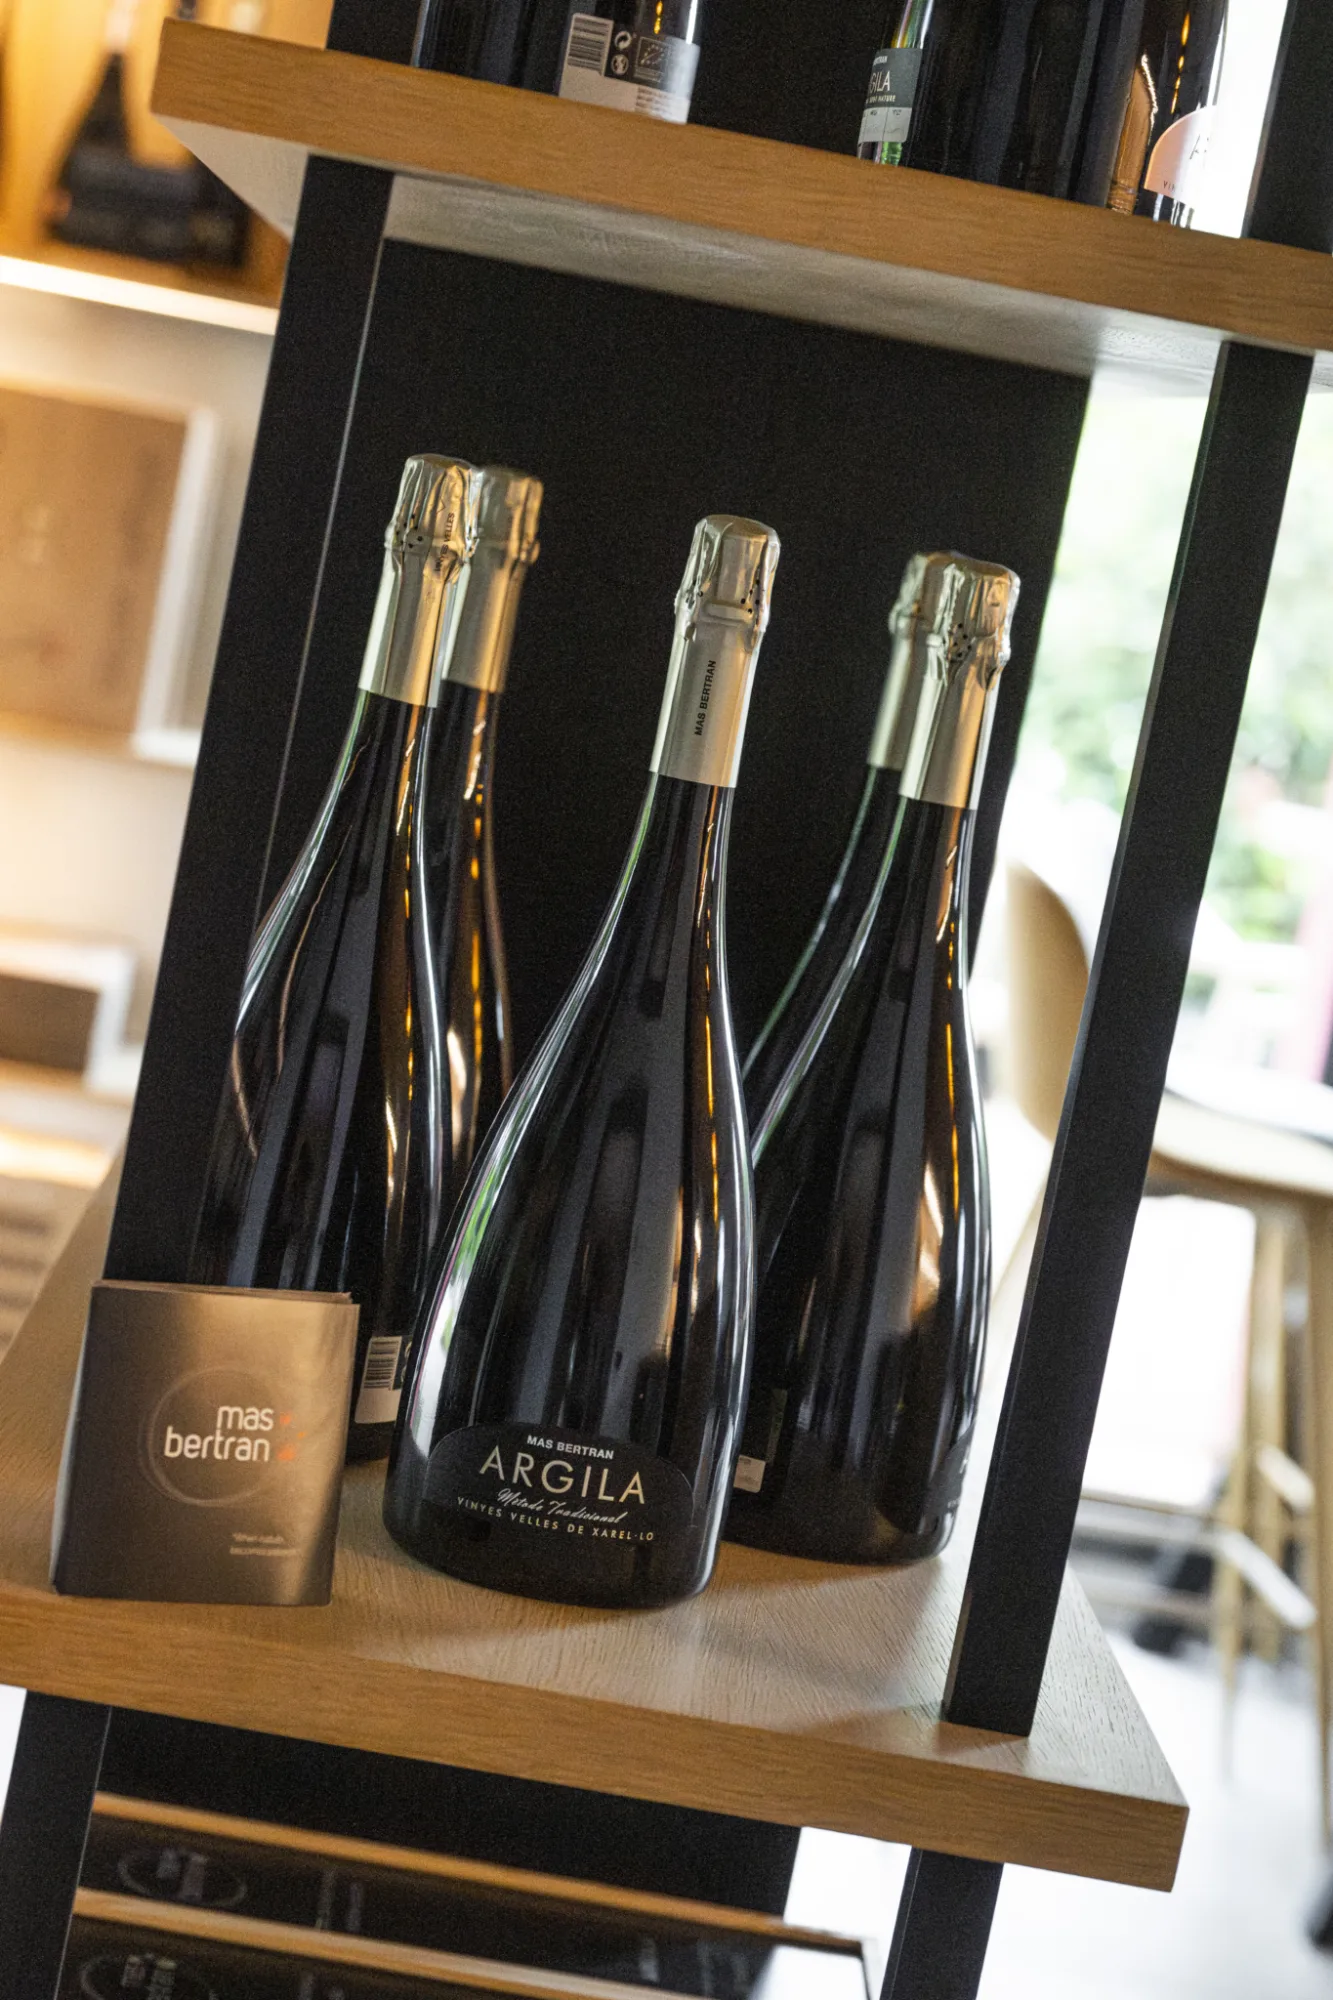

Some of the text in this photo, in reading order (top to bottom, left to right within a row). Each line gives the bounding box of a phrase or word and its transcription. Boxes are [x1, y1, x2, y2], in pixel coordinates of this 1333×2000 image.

[868, 70, 891, 94] GILA
[694, 660, 717, 736] MAS BERTRAN
[216, 1406, 274, 1431] mas
[164, 1425, 270, 1462] bertran
[527, 1435, 614, 1460] MAS BERTRAN
[479, 1445, 645, 1504] ARGILA
[457, 1497, 502, 1518] VINYES
[510, 1512, 560, 1530] VELLES
[567, 1523, 584, 1535] DE
